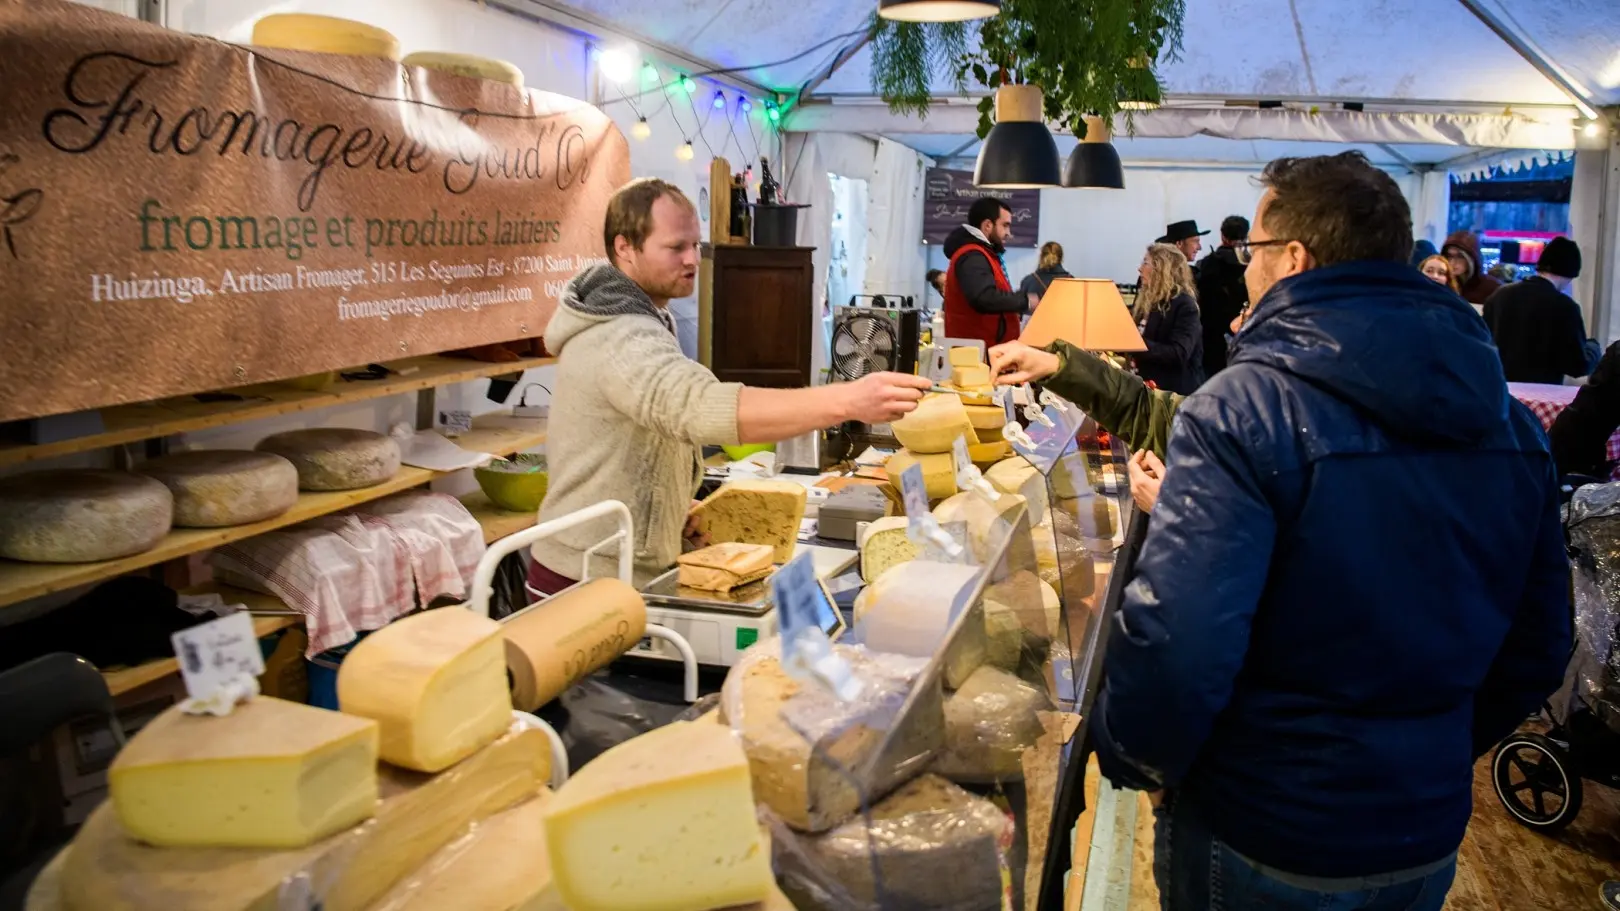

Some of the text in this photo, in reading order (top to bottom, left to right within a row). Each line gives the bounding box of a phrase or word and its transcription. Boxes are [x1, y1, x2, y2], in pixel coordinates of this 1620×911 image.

[41, 51, 430, 212] Fromagerie
[138, 198, 561, 260] fromage et produits laitiers
[218, 266, 293, 294] Artisan
[371, 261, 397, 284] 515
[400, 260, 425, 282] Les
[428, 259, 484, 285] Seguines
[486, 257, 505, 277] Est
[545, 255, 573, 273] Saint
[338, 279, 569, 321] fromageriegoudor@gmail.com 060
